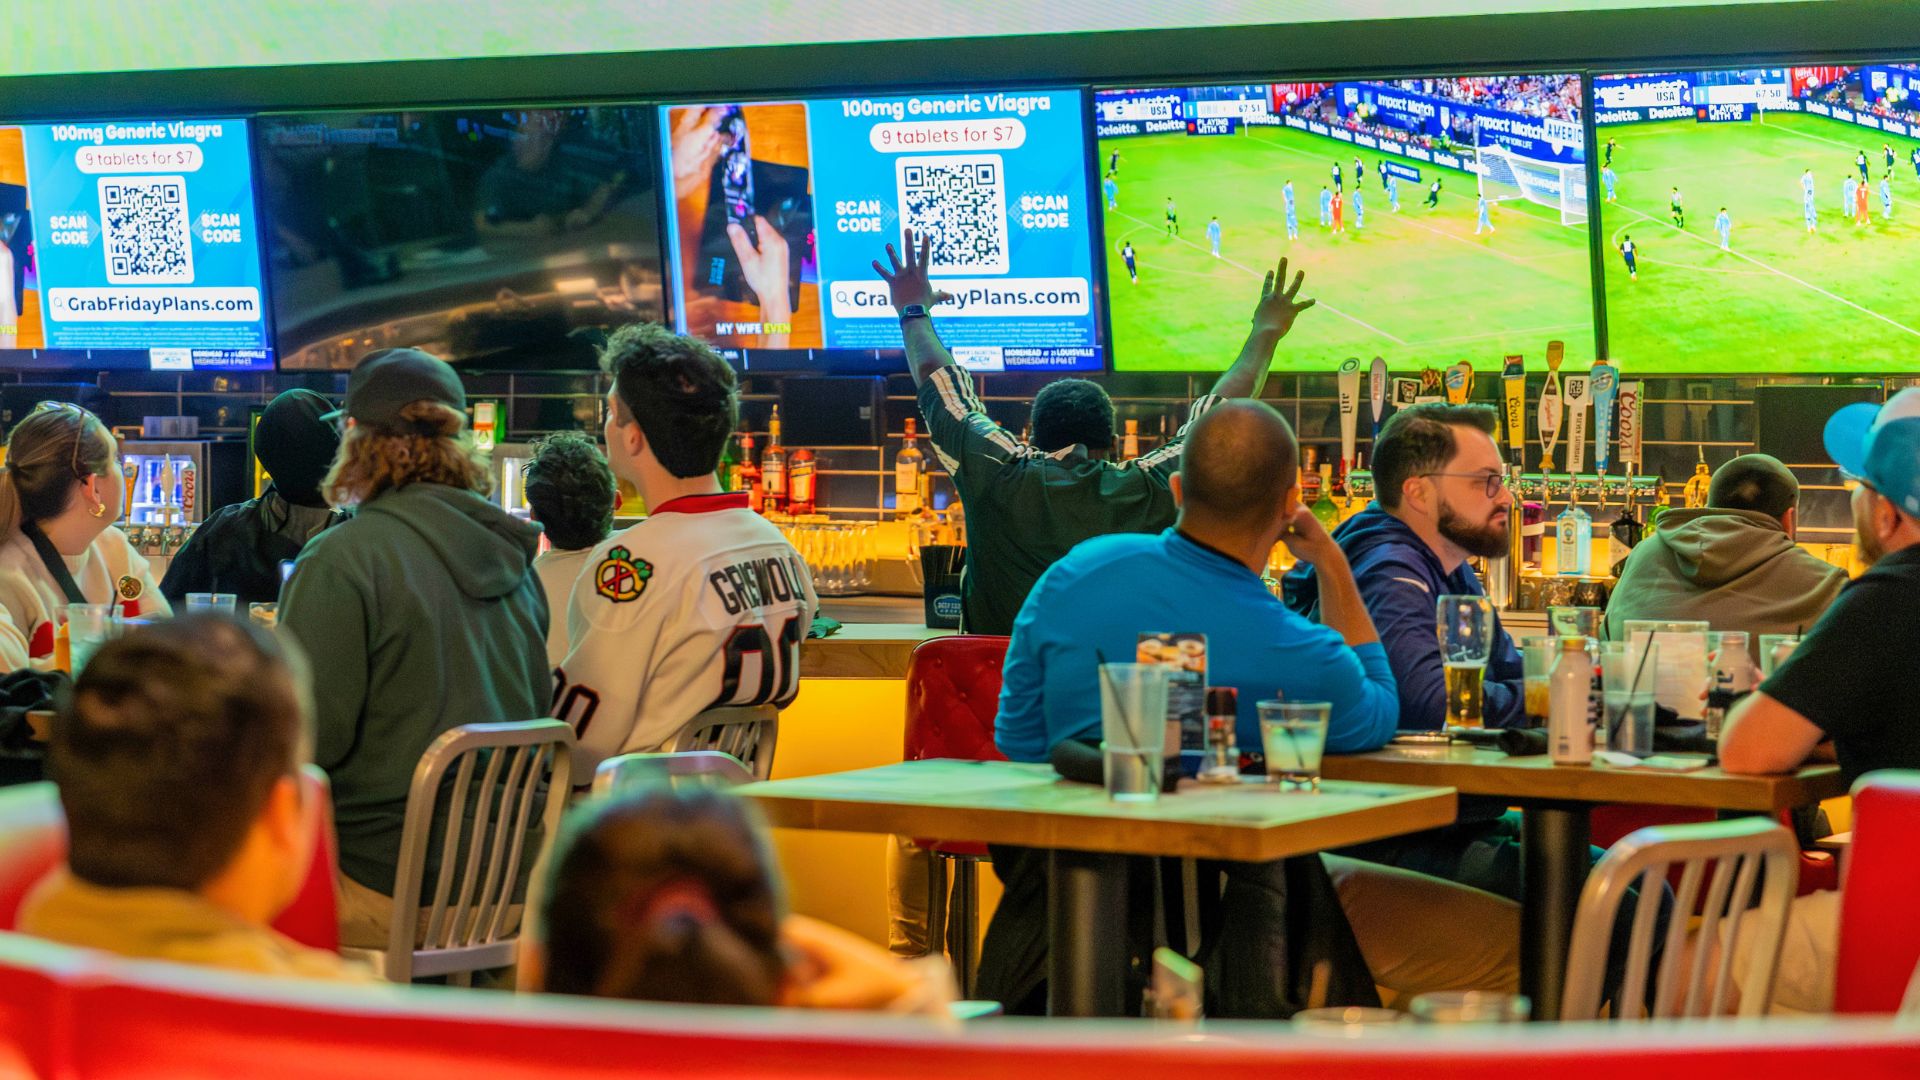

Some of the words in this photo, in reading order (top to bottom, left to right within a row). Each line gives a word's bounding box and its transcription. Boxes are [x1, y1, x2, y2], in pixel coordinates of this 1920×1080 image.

[1377, 94, 1407, 111] Impact
[1656, 91, 1675, 102] USA
[1683, 90, 1691, 102] 4
[842, 100, 904, 121] 100mg
[907, 95, 982, 115] Generic
[984, 93, 1050, 117] Viagra
[1151, 105, 1168, 115] USA
[1174, 105, 1182, 117] 4
[1708, 104, 1744, 113] PLAYING
[1197, 117, 1229, 126] PLAYING
[1708, 111, 1731, 121] WITH
[52, 125, 104, 145] 100mg
[106, 122, 166, 140] Generic
[168, 121, 222, 143] Viagra
[882, 129, 891, 145] 9
[897, 128, 959, 144] tablets
[964, 127, 988, 142] for
[993, 126, 1014, 142] $7
[86, 152, 94, 166] 9
[97, 152, 148, 166] tablets
[153, 151, 172, 165] for
[176, 150, 194, 165] $7
[836, 200, 881, 215] SCAN
[1020, 195, 1068, 211] SCAN
[50, 215, 88, 230] SCAN
[201, 213, 241, 227] SCAN
[837, 217, 882, 232] CODE
[1022, 213, 1069, 229] CODE
[51, 231, 89, 245] CODE
[202, 229, 241, 243] CODE
[68, 295, 254, 315] GrabFridayPlans.com
[716, 322, 734, 335] MY
[735, 322, 762, 335] WIFE
[763, 322, 792, 335] EVEN
[1057, 348, 1094, 357] LOUISVILLE
[1620, 390, 1638, 450] Coors
